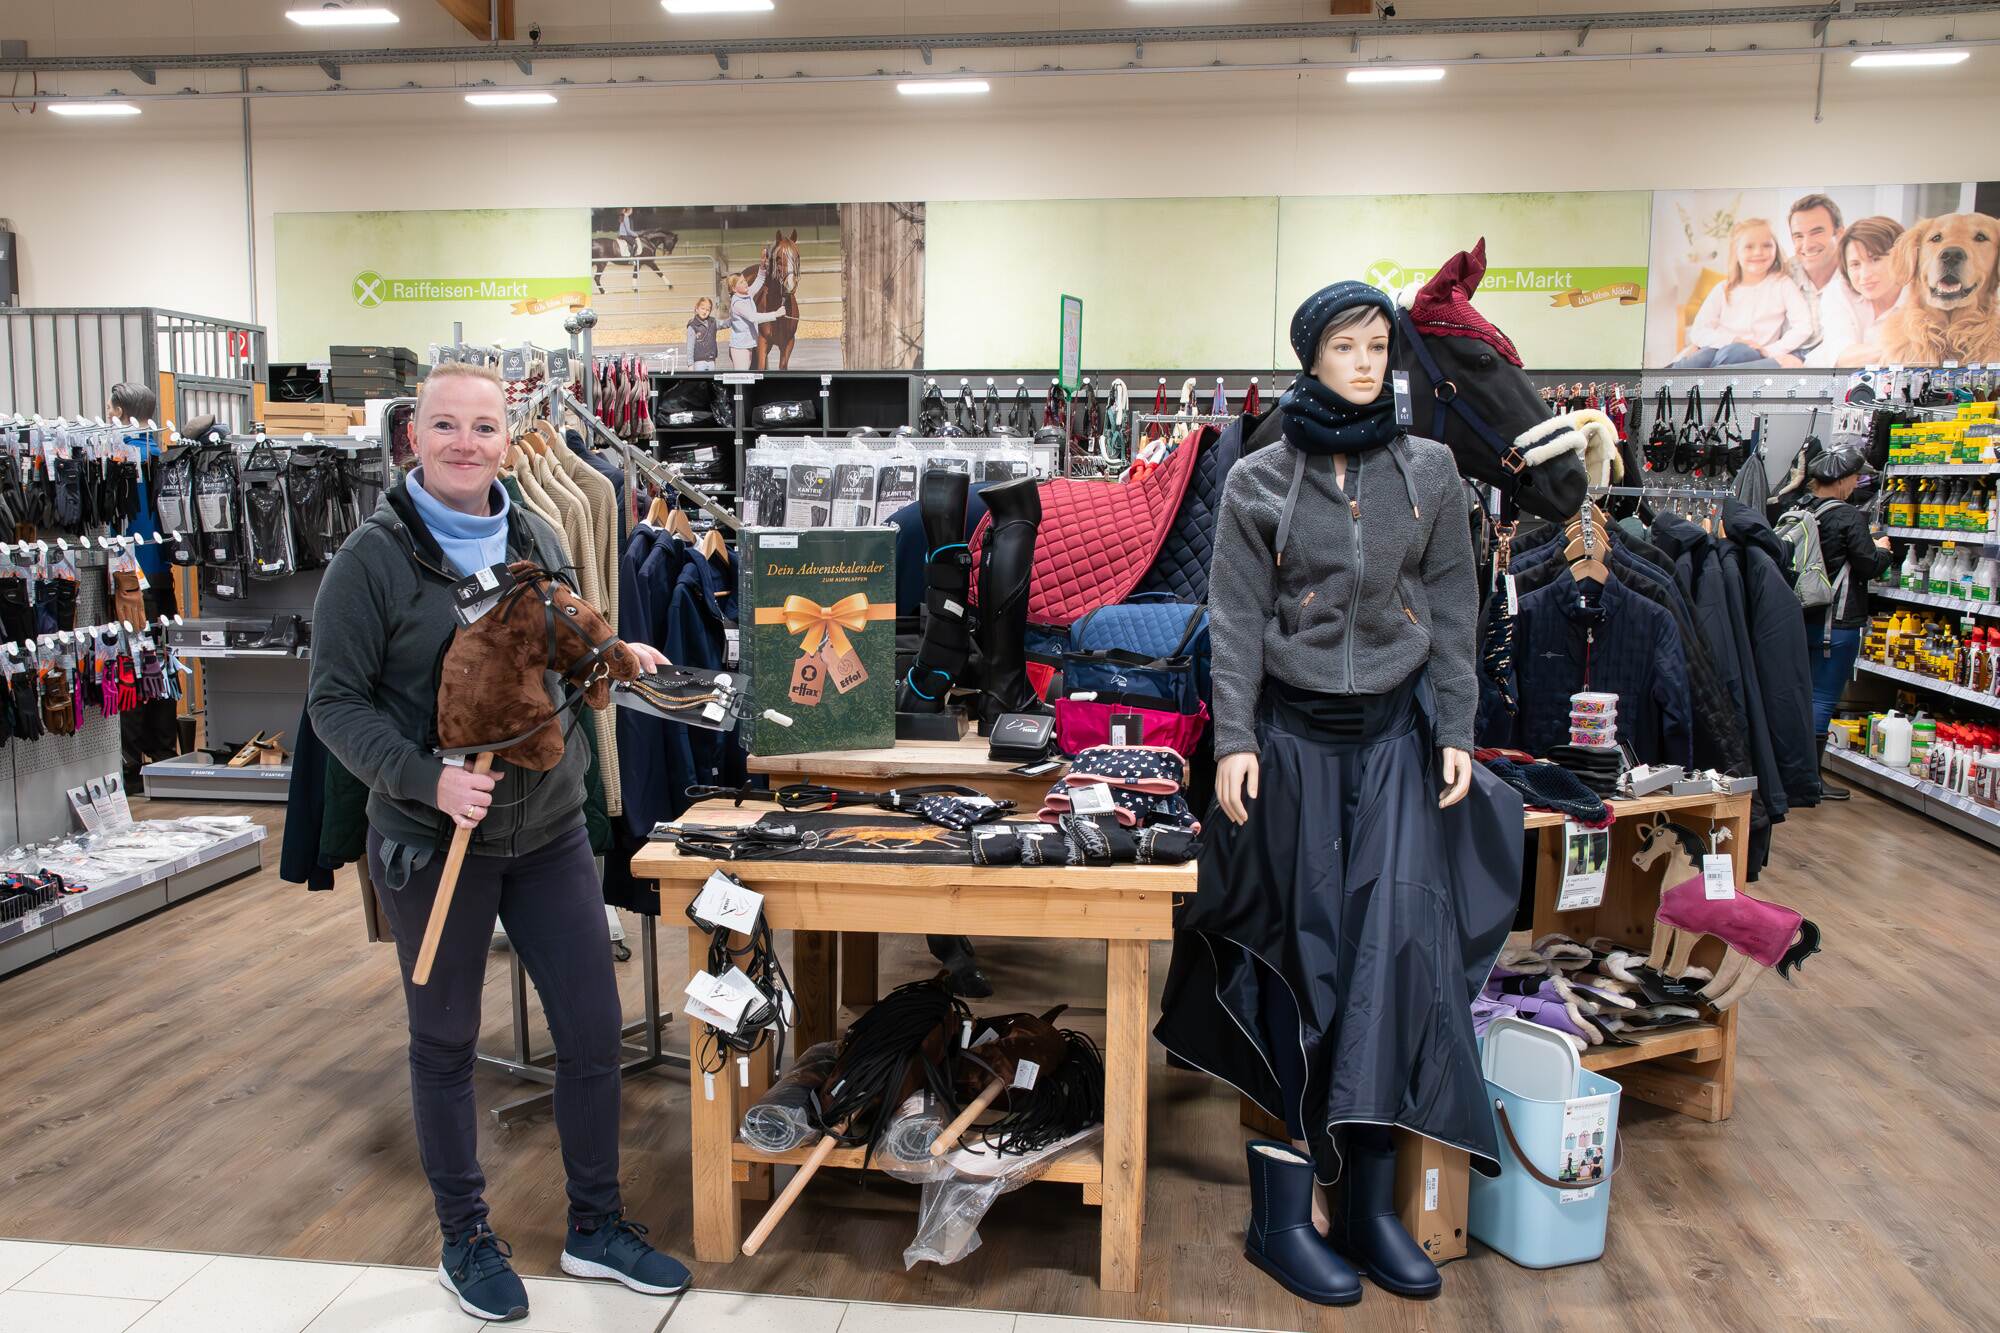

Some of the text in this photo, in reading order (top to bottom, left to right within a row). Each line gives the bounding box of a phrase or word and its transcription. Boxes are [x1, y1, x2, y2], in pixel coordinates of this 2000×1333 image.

[1413, 270, 1573, 289] Ren-Markt
[393, 281, 529, 298] Raiffeisen-Markt
[767, 560, 885, 577] Dein Adventskalender
[839, 671, 862, 689] Effol
[792, 682, 819, 698] effax
